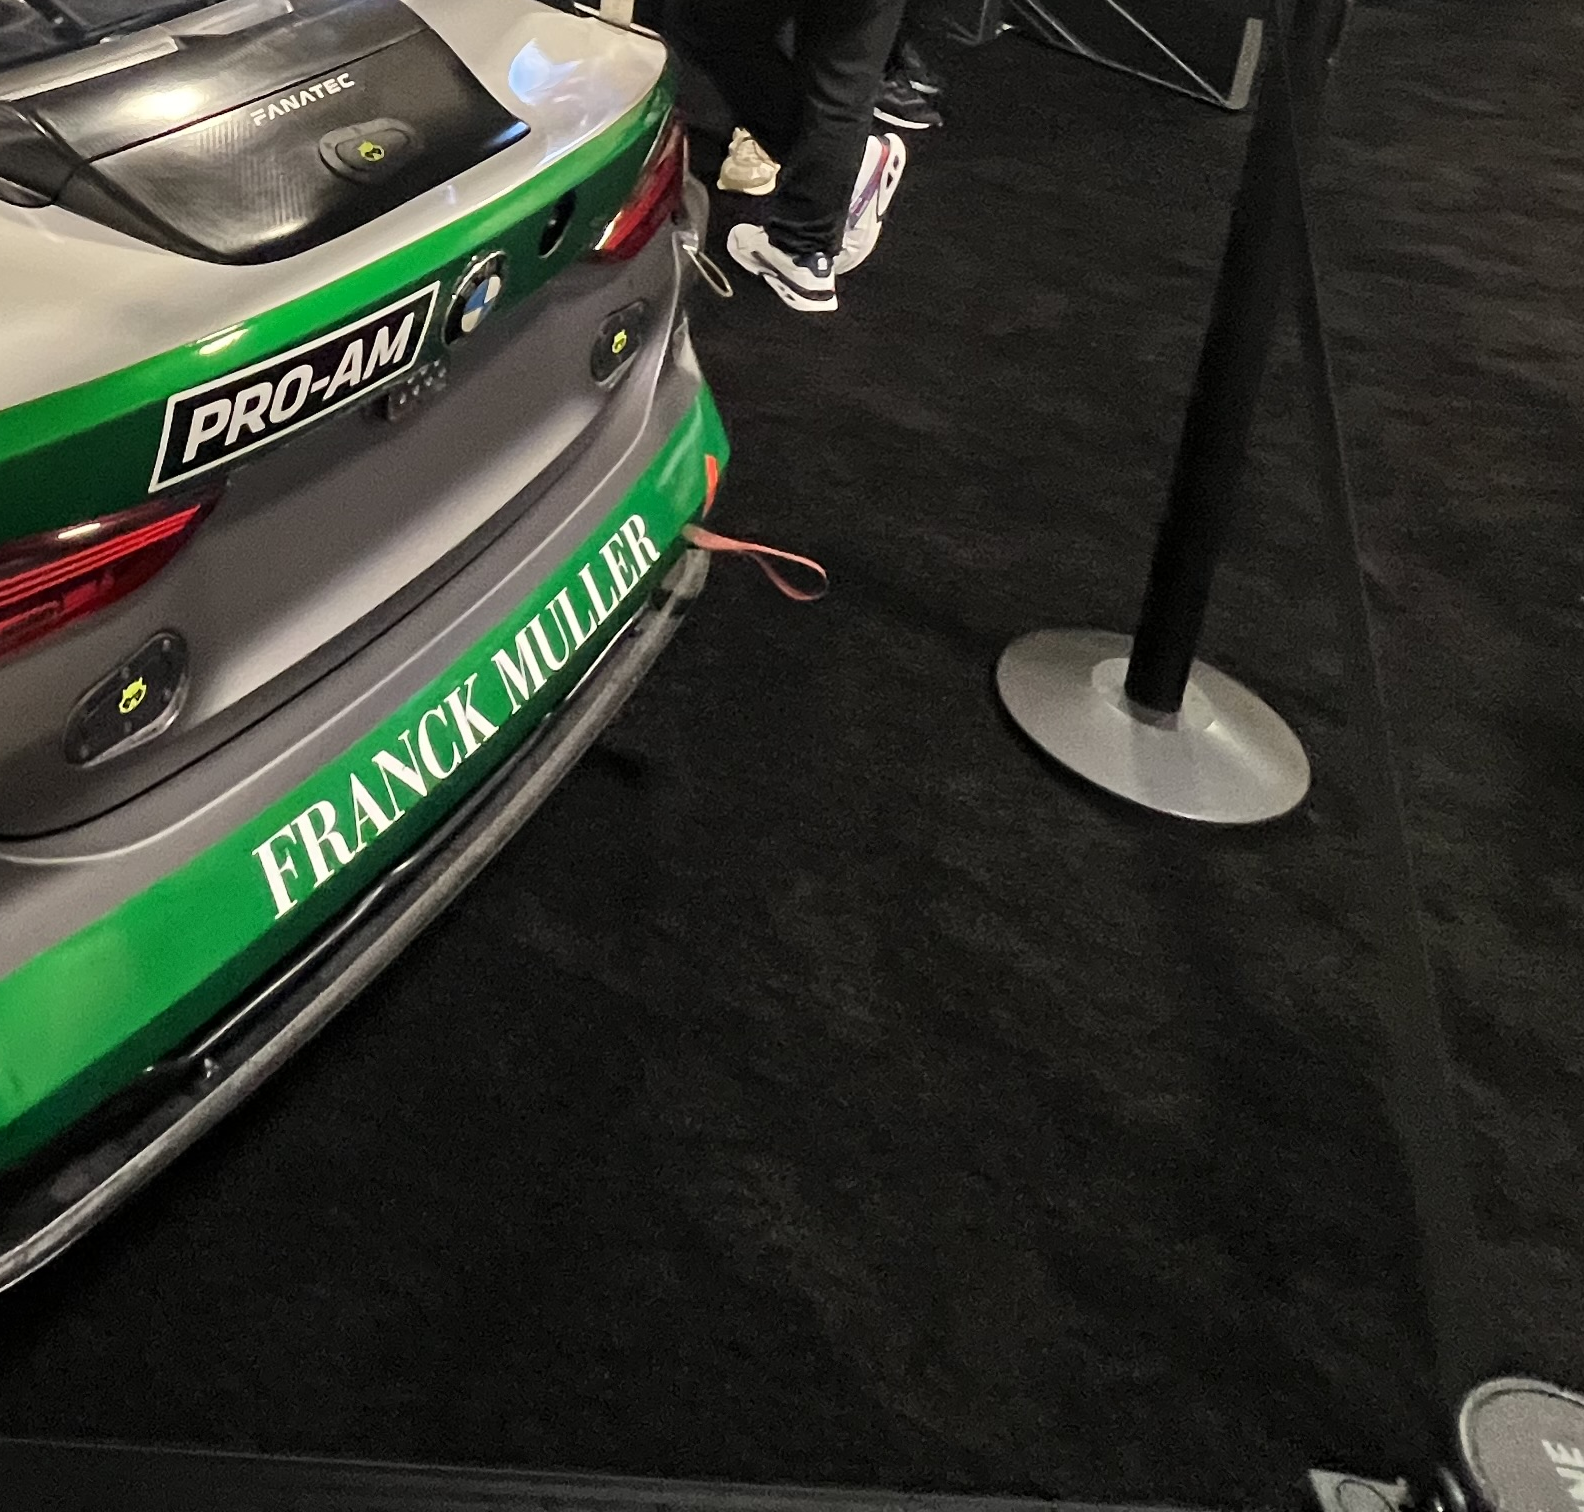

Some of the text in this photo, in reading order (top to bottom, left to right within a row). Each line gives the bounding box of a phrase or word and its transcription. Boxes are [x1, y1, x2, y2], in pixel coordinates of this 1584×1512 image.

[250, 72, 355, 126] FANATEC
[182, 312, 414, 463] PRO-AM
[252, 513, 661, 919] FRANCK MULLER
